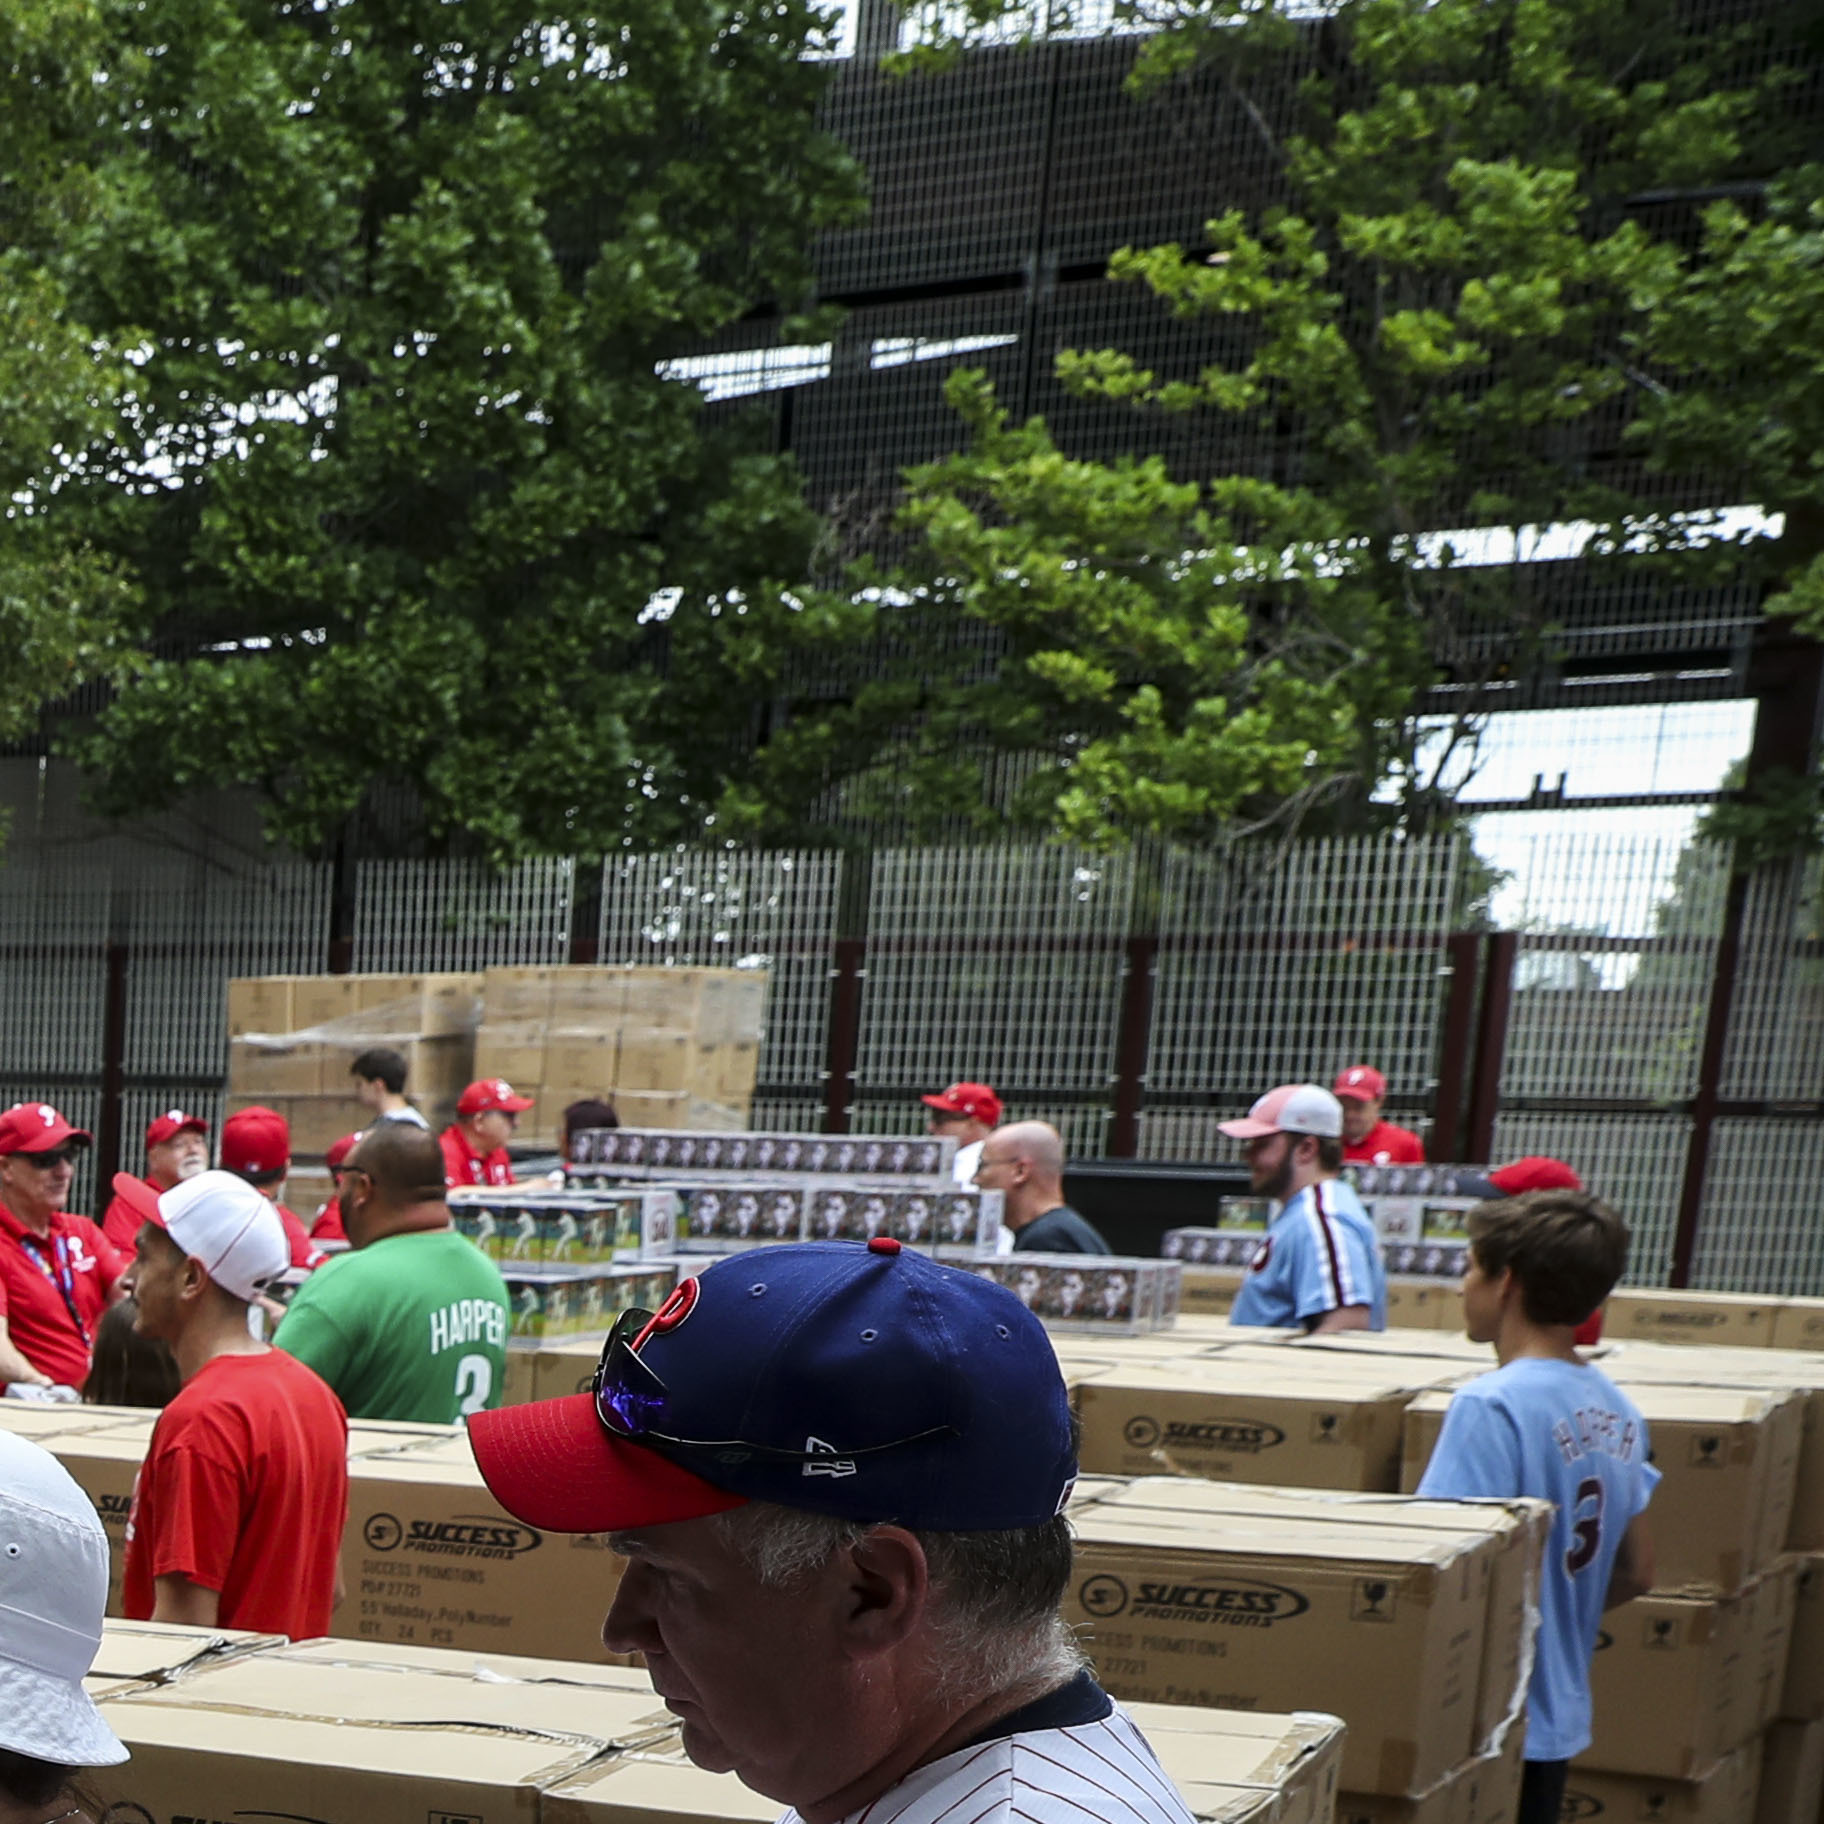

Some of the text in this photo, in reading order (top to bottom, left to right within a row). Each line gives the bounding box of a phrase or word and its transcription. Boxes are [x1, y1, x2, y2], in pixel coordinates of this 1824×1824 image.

[430, 1299, 506, 1356] HARPER
[1164, 1421, 1267, 1446] SUCCESS
[406, 1519, 521, 1549] SUCCESS
[1565, 1476, 1604, 1580] 3
[403, 1539, 515, 1561] PROMOTIONS
[1132, 1583, 1281, 1614] SUCCESS
[1129, 1605, 1274, 1628] PROMOTIONS
